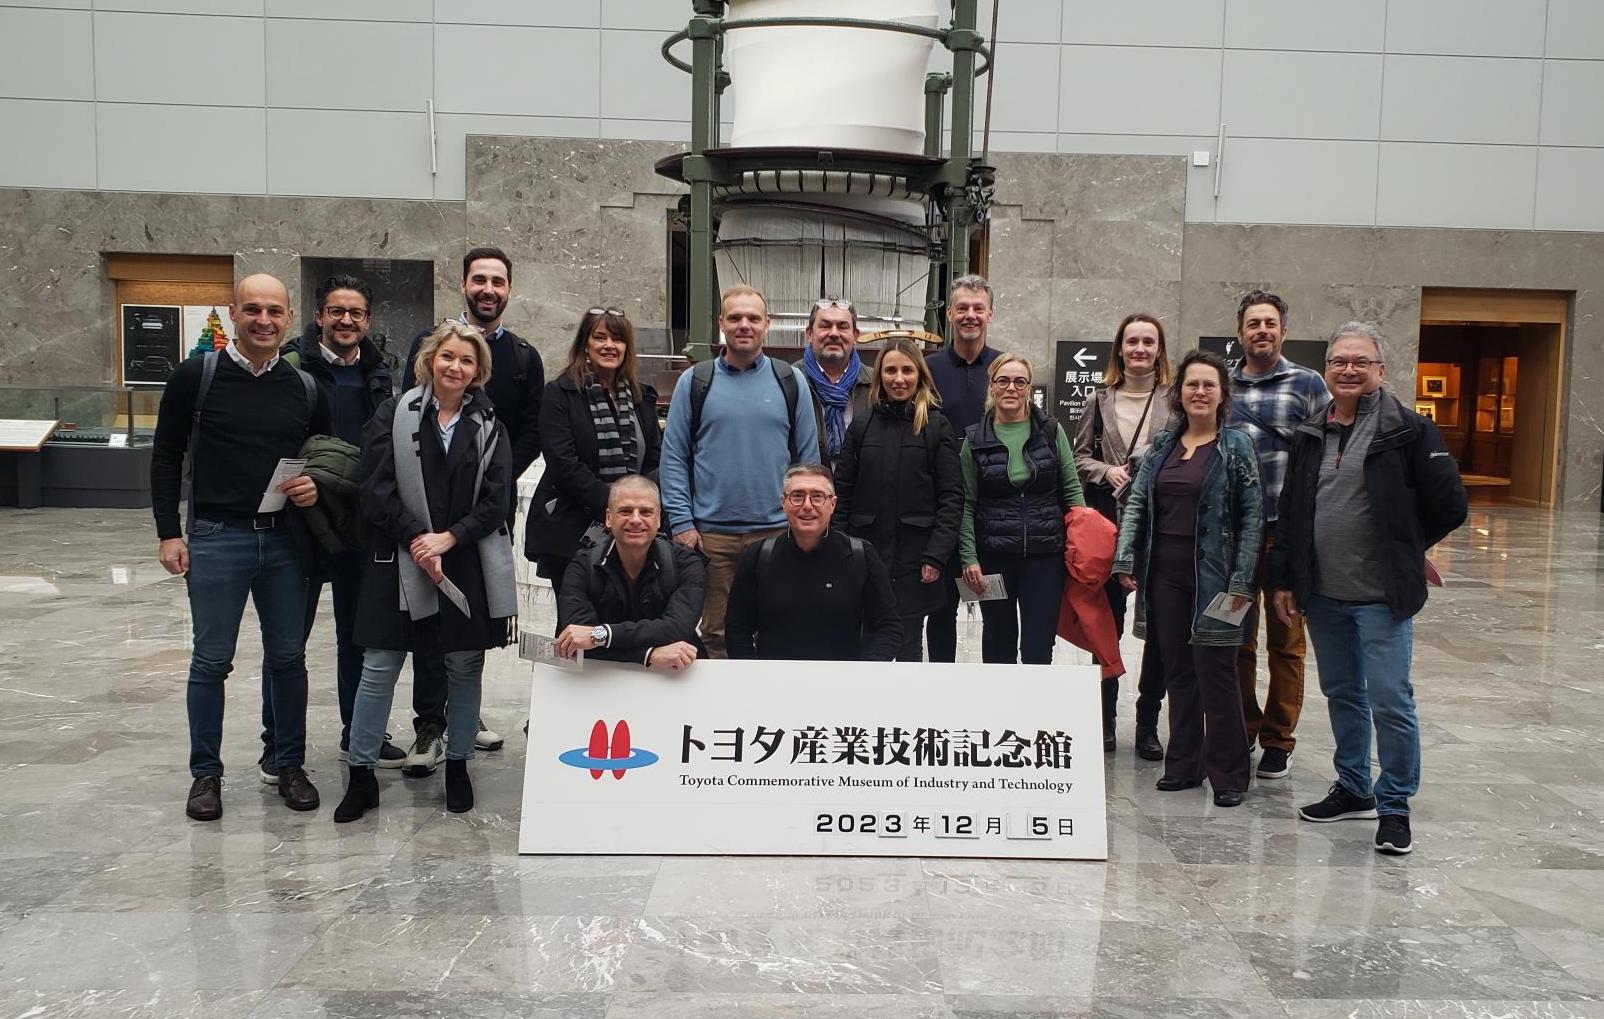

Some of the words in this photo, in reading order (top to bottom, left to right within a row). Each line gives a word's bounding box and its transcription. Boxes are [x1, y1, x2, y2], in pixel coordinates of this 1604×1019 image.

[1065, 371, 1103, 383] 展示場
[680, 724, 1074, 770] トヨタ産業技術記念館
[679, 774, 725, 788] Toyota
[727, 774, 835, 788] Commemorative
[837, 776, 894, 788] Museum
[896, 776, 911, 788] of
[913, 777, 969, 791] Industry
[972, 778, 996, 789] and
[998, 778, 1073, 794] Technology
[816, 813, 902, 834] 2023
[912, 815, 931, 834] 年
[941, 815, 973, 835] 12
[985, 817, 1002, 835] 月
[1032, 816, 1049, 836] 5
[1058, 818, 1074, 837] 日
